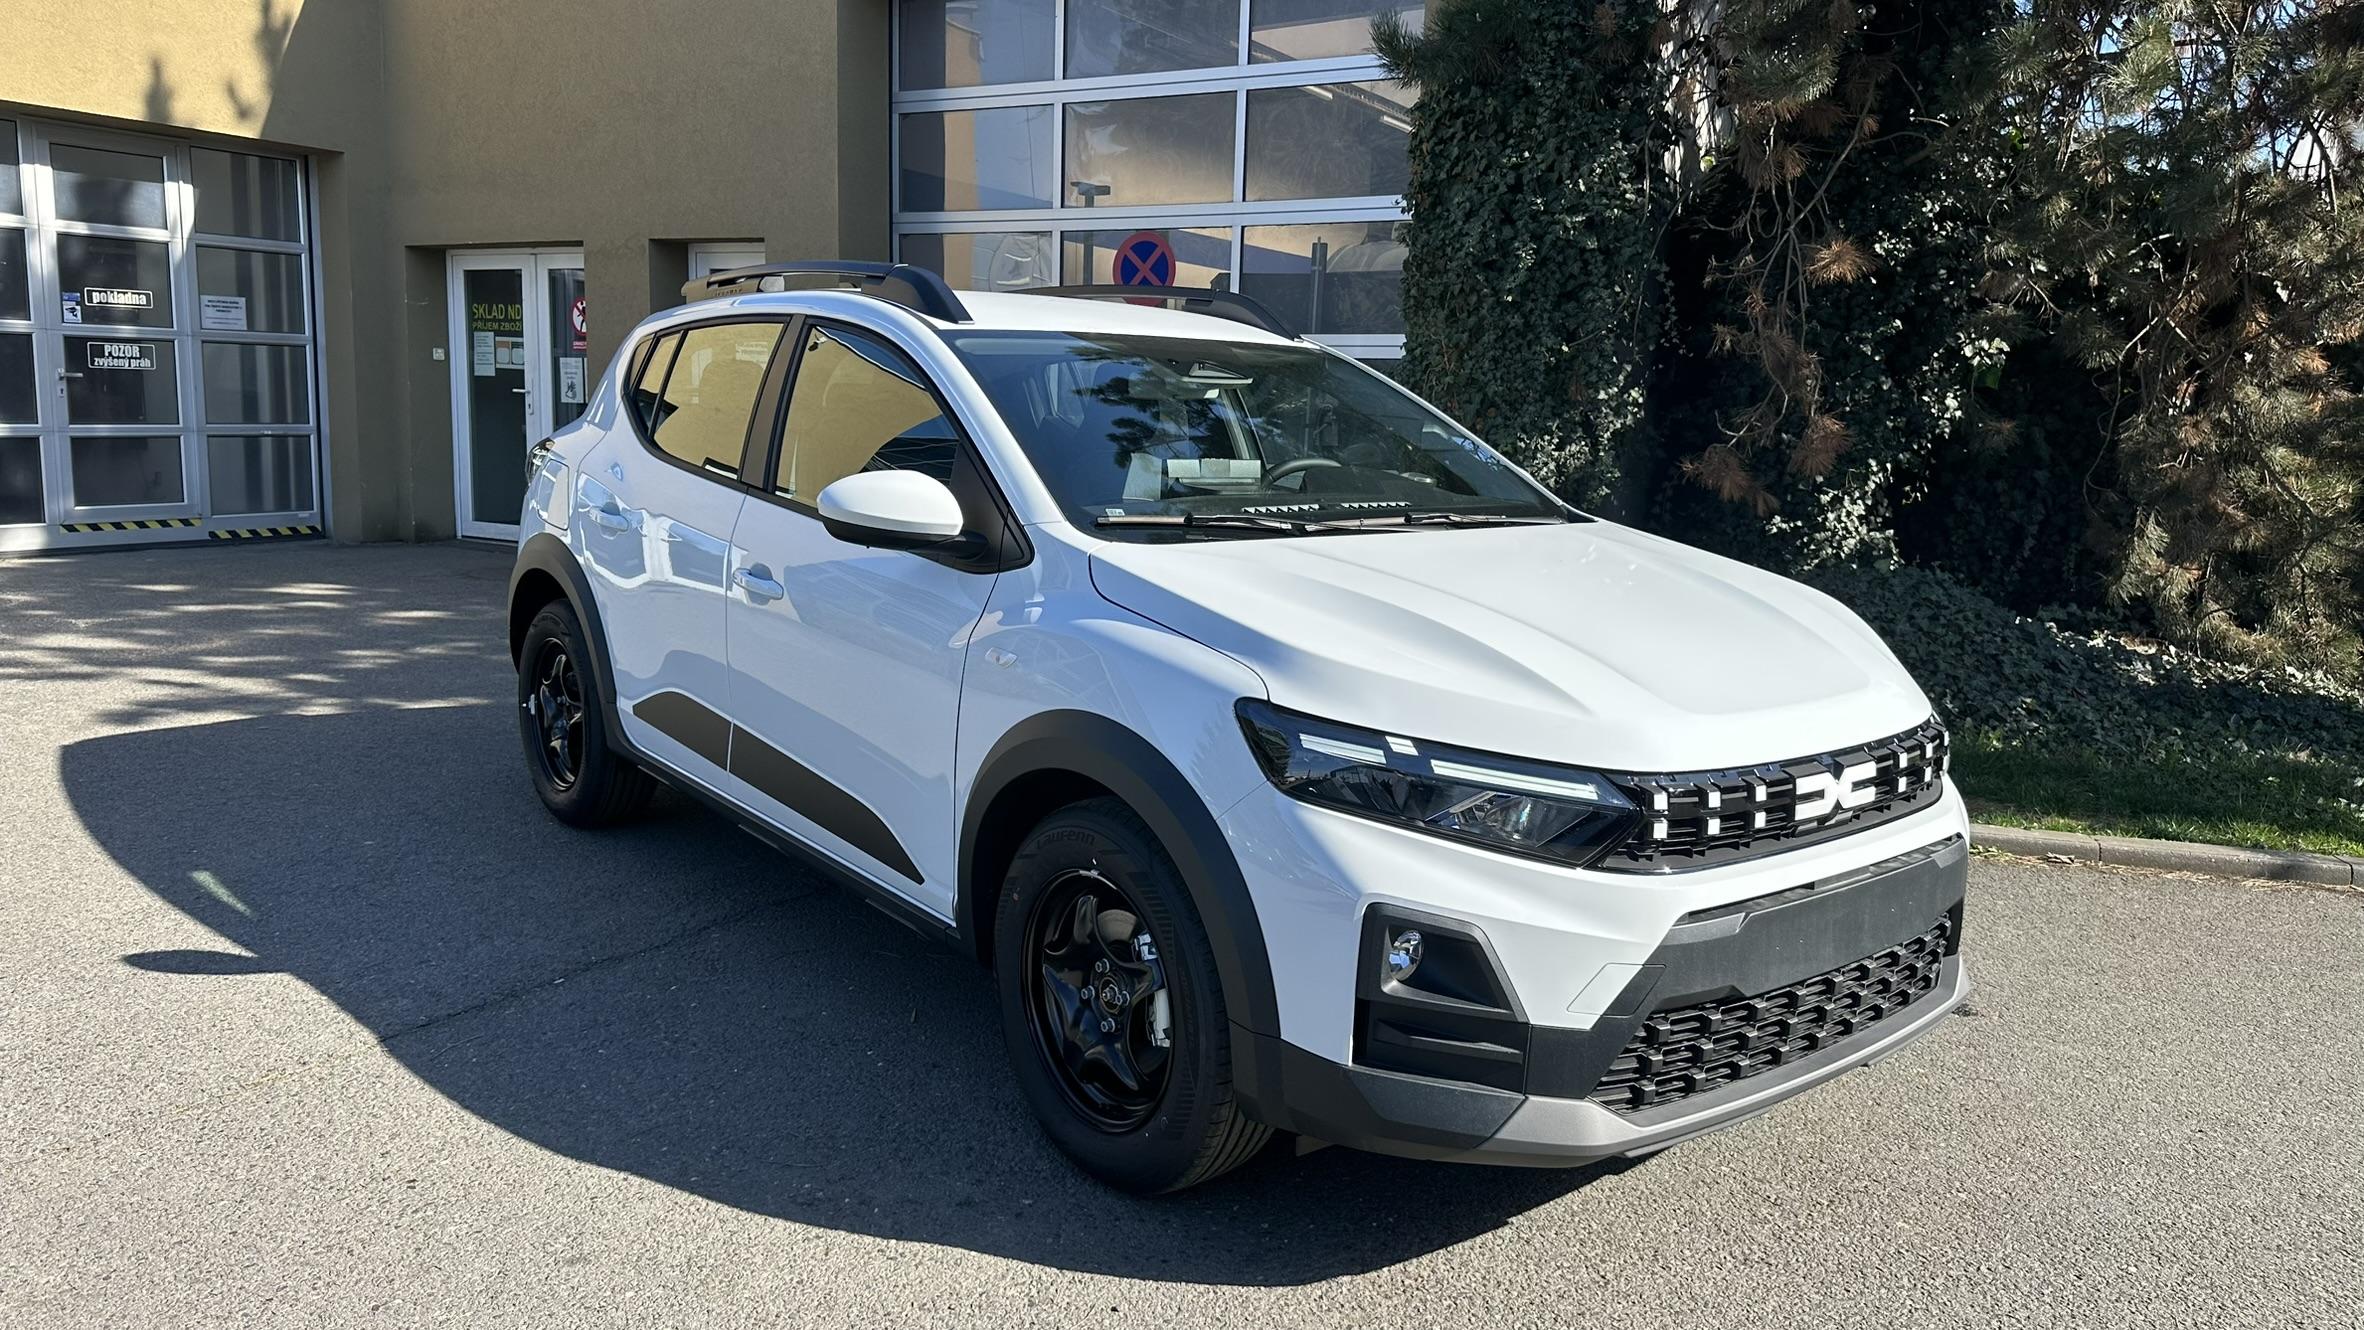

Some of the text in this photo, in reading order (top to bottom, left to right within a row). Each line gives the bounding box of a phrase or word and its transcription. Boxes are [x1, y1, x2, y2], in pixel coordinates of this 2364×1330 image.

[92, 291, 147, 305] pokladna
[472, 303, 522, 320] SKLAD ND
[104, 344, 140, 357] POZOR
[94, 357, 151, 368] zvýšený práh
